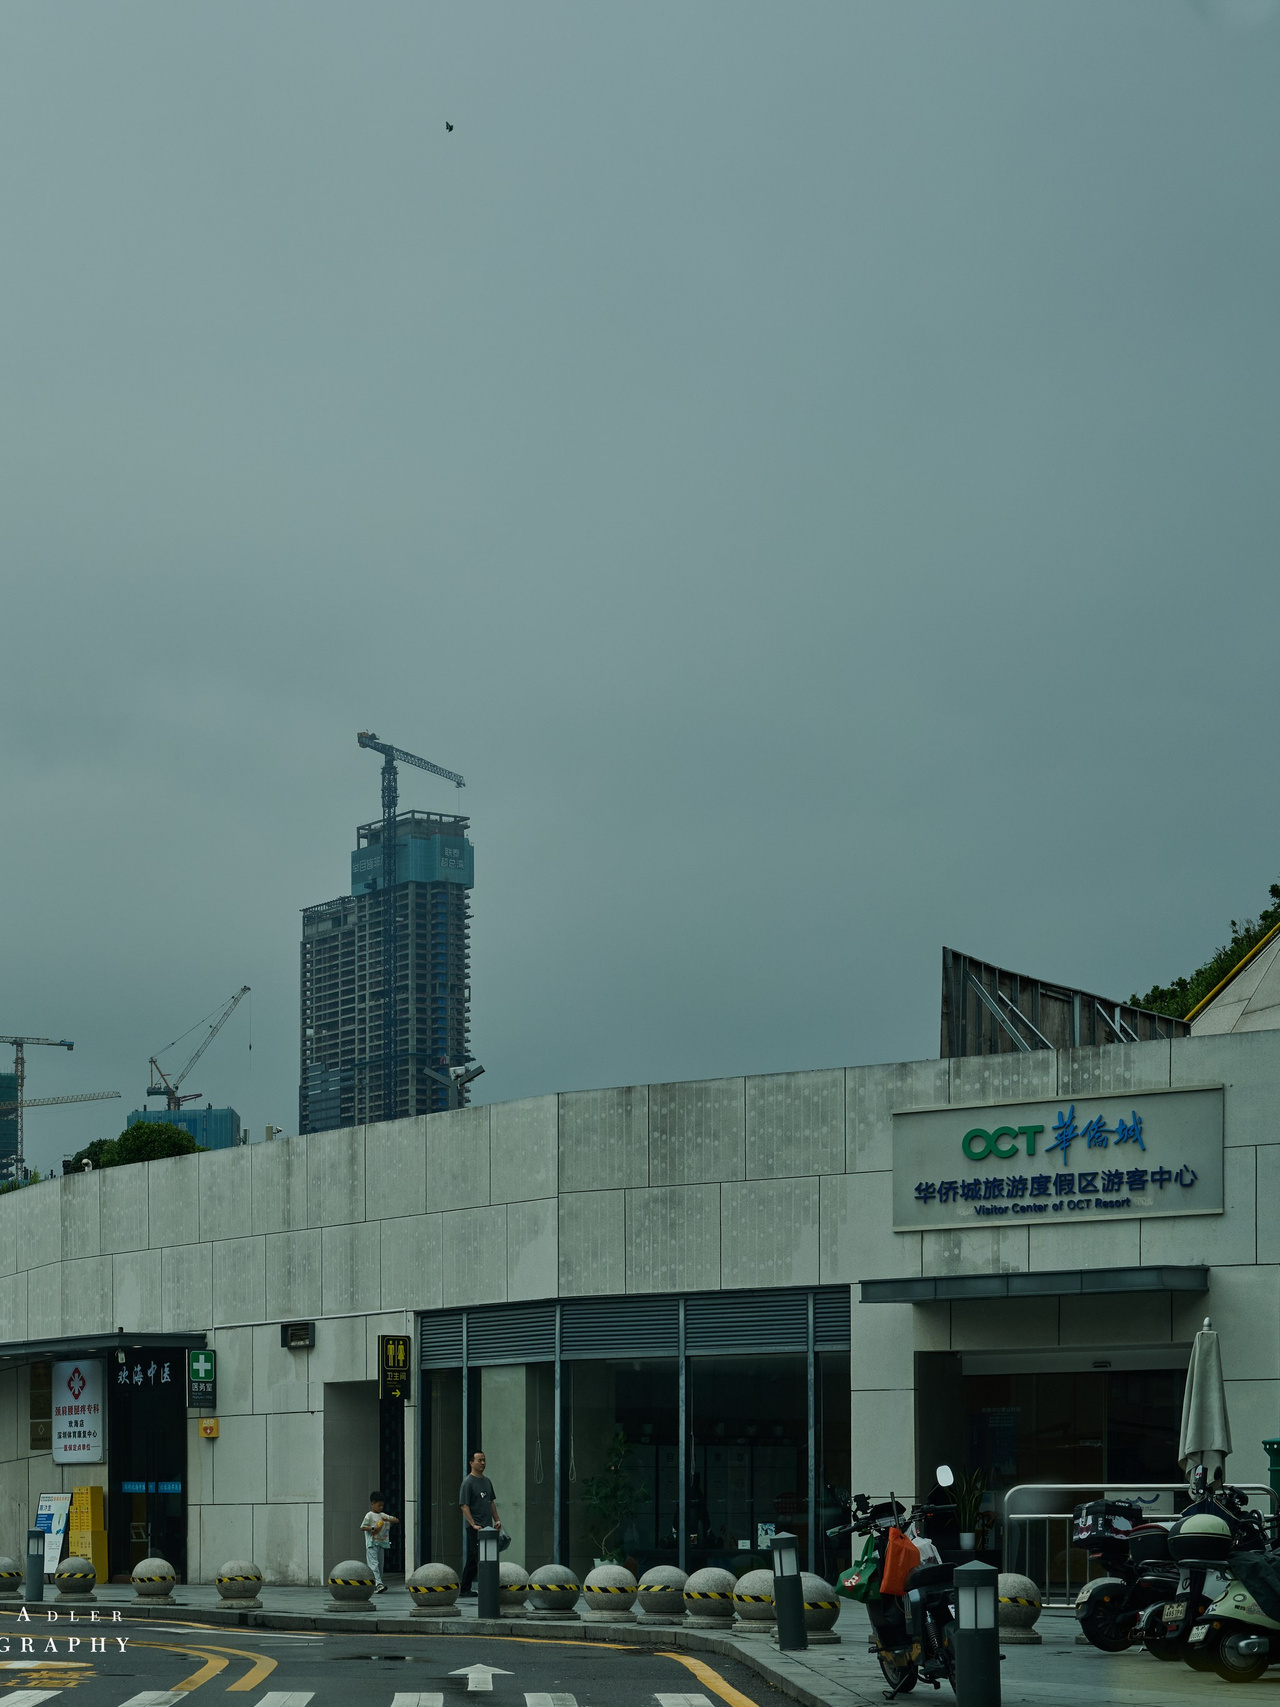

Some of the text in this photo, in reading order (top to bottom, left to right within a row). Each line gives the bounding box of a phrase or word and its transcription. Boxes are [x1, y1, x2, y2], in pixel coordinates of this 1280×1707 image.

[962, 1125, 1044, 1160] OCT
[914, 1164, 1198, 1205] 华侨城旅游度假区游客中心
[974, 1197, 1131, 1216] Visitor Center of OCT Resort
[386, 1372, 407, 1381] 卫生间
[192, 1383, 213, 1392] 医务室
